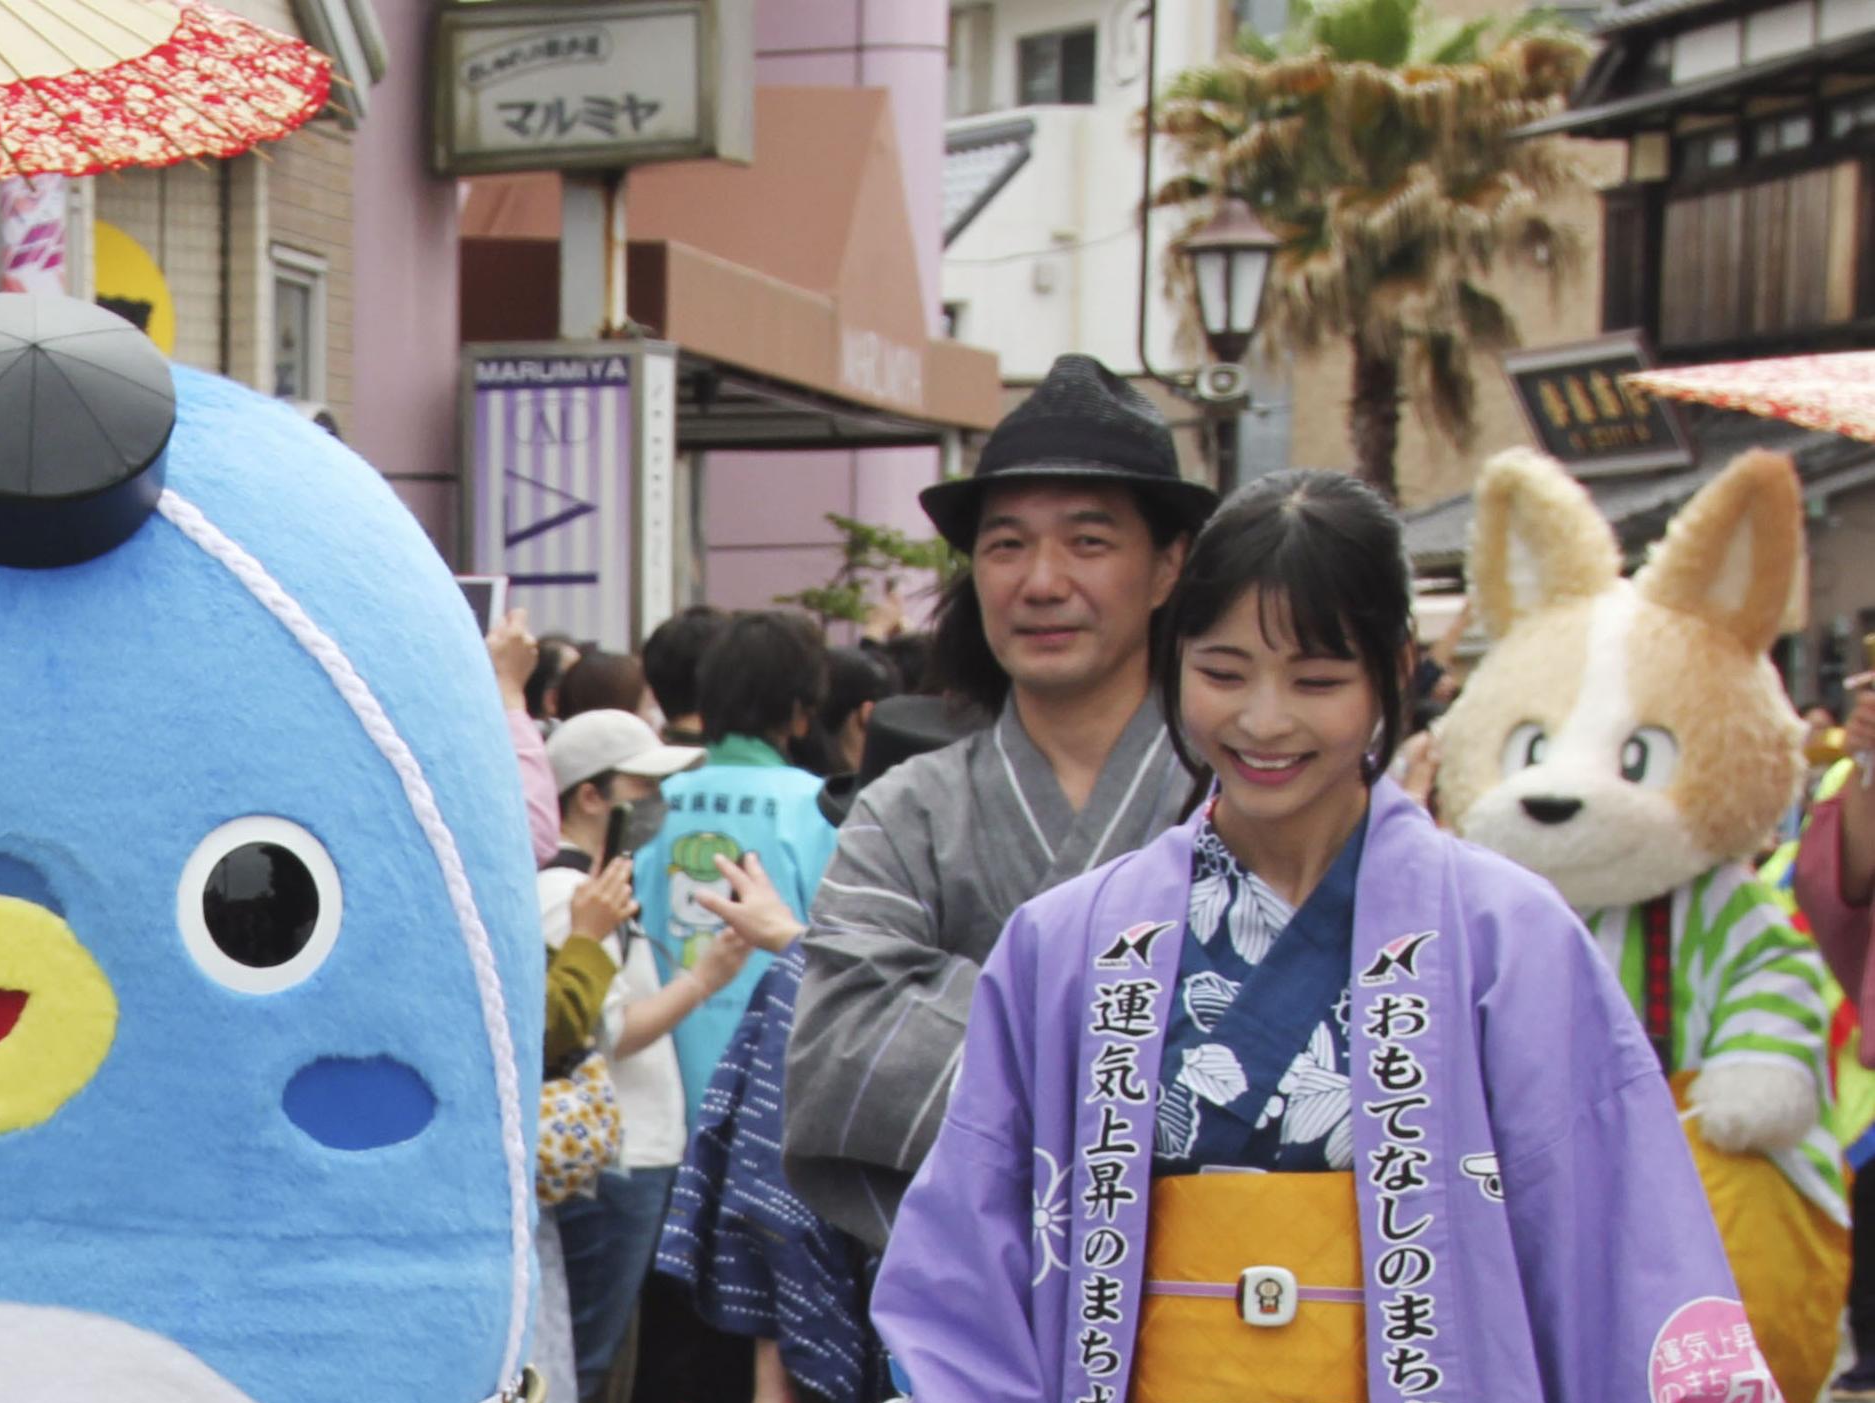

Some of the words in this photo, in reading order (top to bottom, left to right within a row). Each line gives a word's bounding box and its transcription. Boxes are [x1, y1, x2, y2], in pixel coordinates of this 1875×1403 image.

[495, 92, 661, 136] マルミヤ
[476, 358, 627, 381] MARUMIYA
